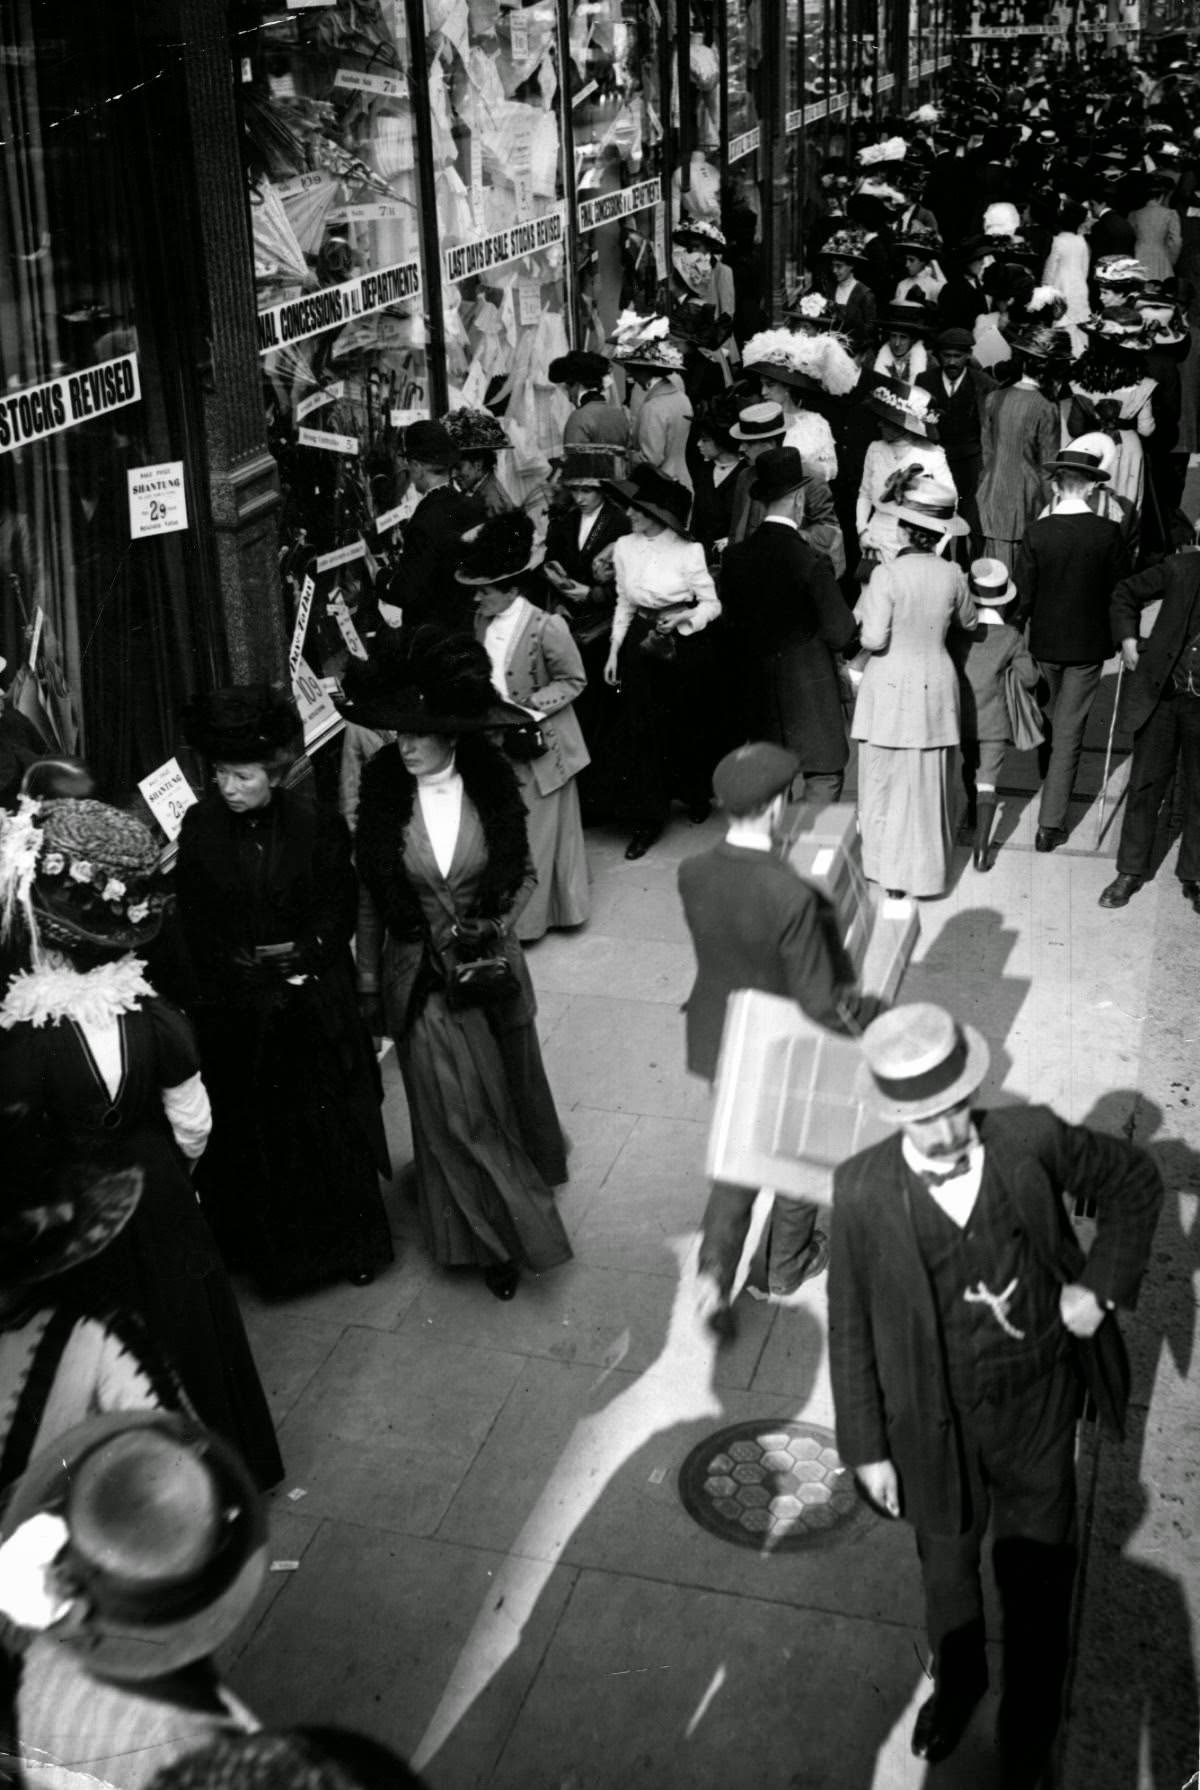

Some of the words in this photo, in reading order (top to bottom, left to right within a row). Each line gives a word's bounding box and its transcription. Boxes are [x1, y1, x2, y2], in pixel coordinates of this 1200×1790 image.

[448, 247, 465, 280] LAST
[466, 241, 484, 273] DAYS
[484, 237, 493, 267] OF
[493, 232, 509, 263] SALE
[510, 222, 535, 257] STOCKS
[536, 214, 560, 248] REVISED
[280, 288, 343, 342] CONCESSIONS
[361, 262, 419, 311] DEPARTMENTS
[0, 383, 66, 447] STOCKS
[68, 359, 135, 420] REVISED
[132, 478, 181, 495] SHANTUNG
[148, 774, 182, 802] SHANTUNG
